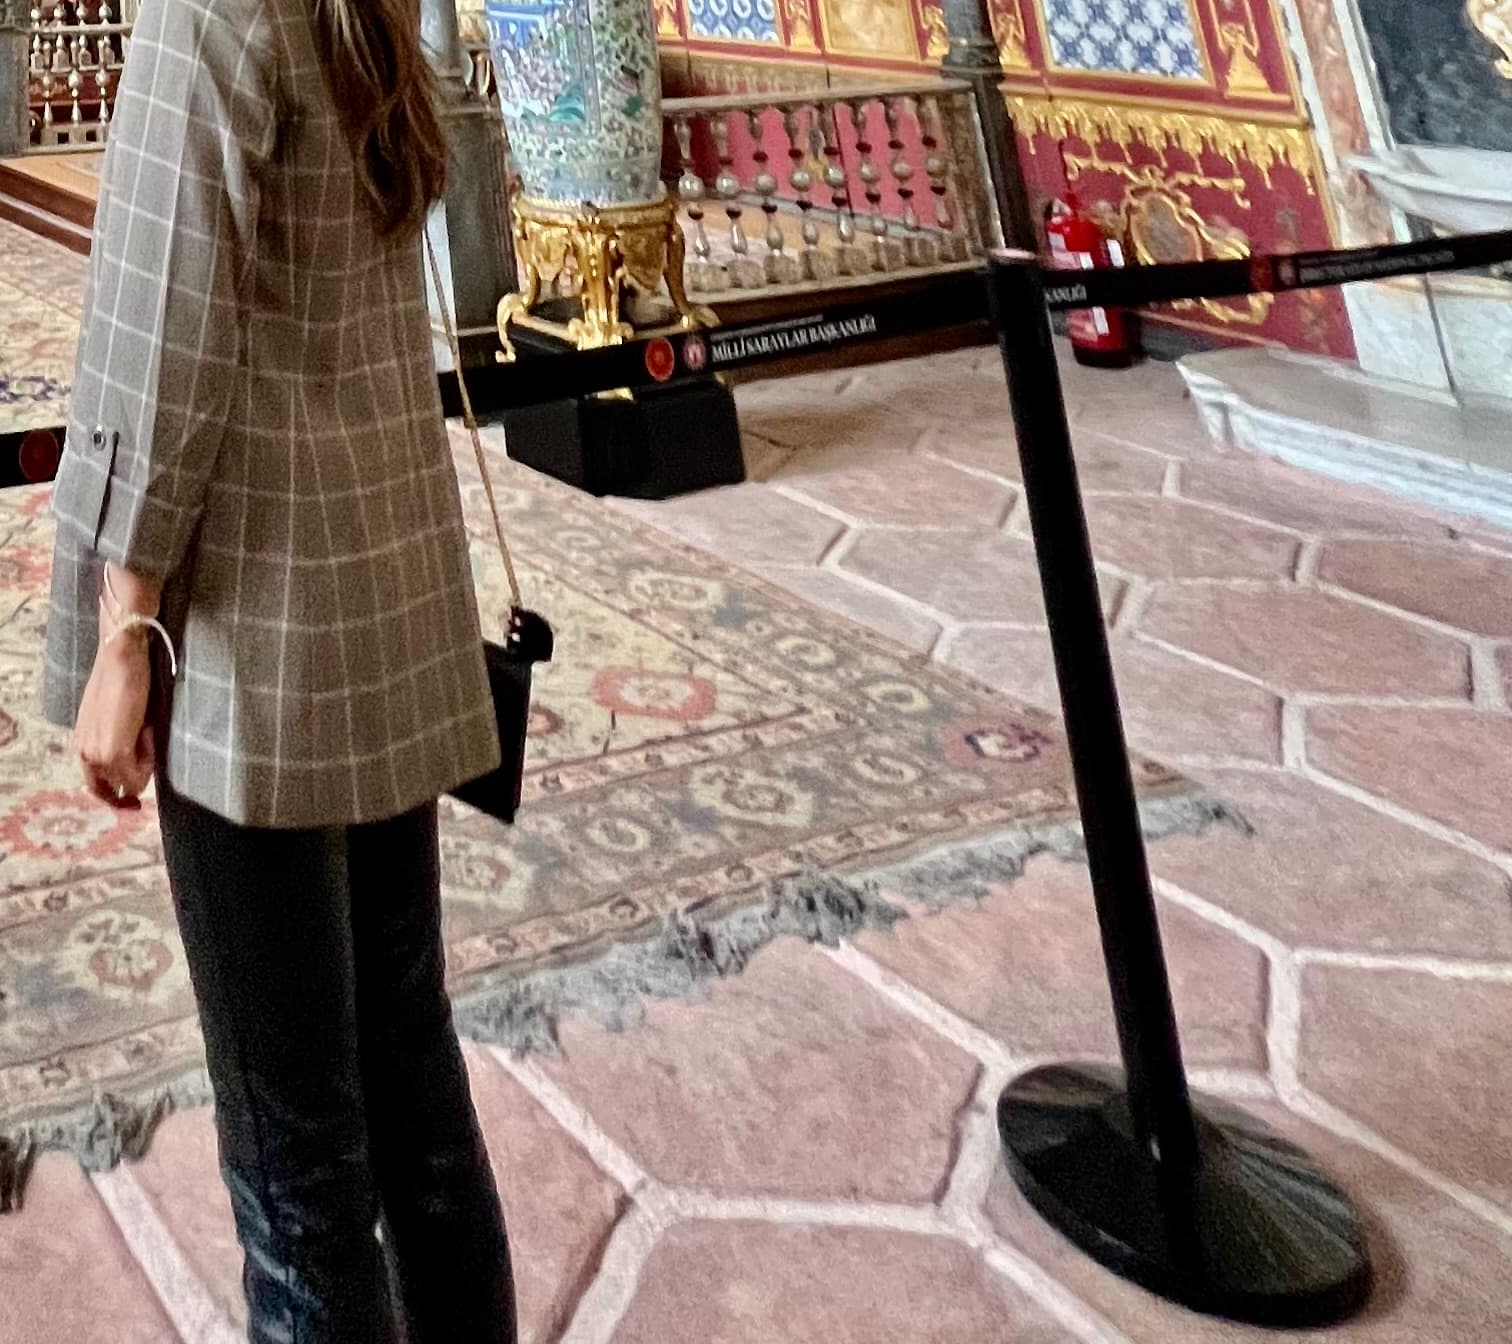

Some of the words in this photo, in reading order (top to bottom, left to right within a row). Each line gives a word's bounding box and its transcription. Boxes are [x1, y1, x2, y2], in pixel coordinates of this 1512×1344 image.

[712, 336, 745, 362] MİLLİ
[746, 327, 808, 354] SARAYLAR
[809, 314, 877, 344] BAŞKANLIĞI
